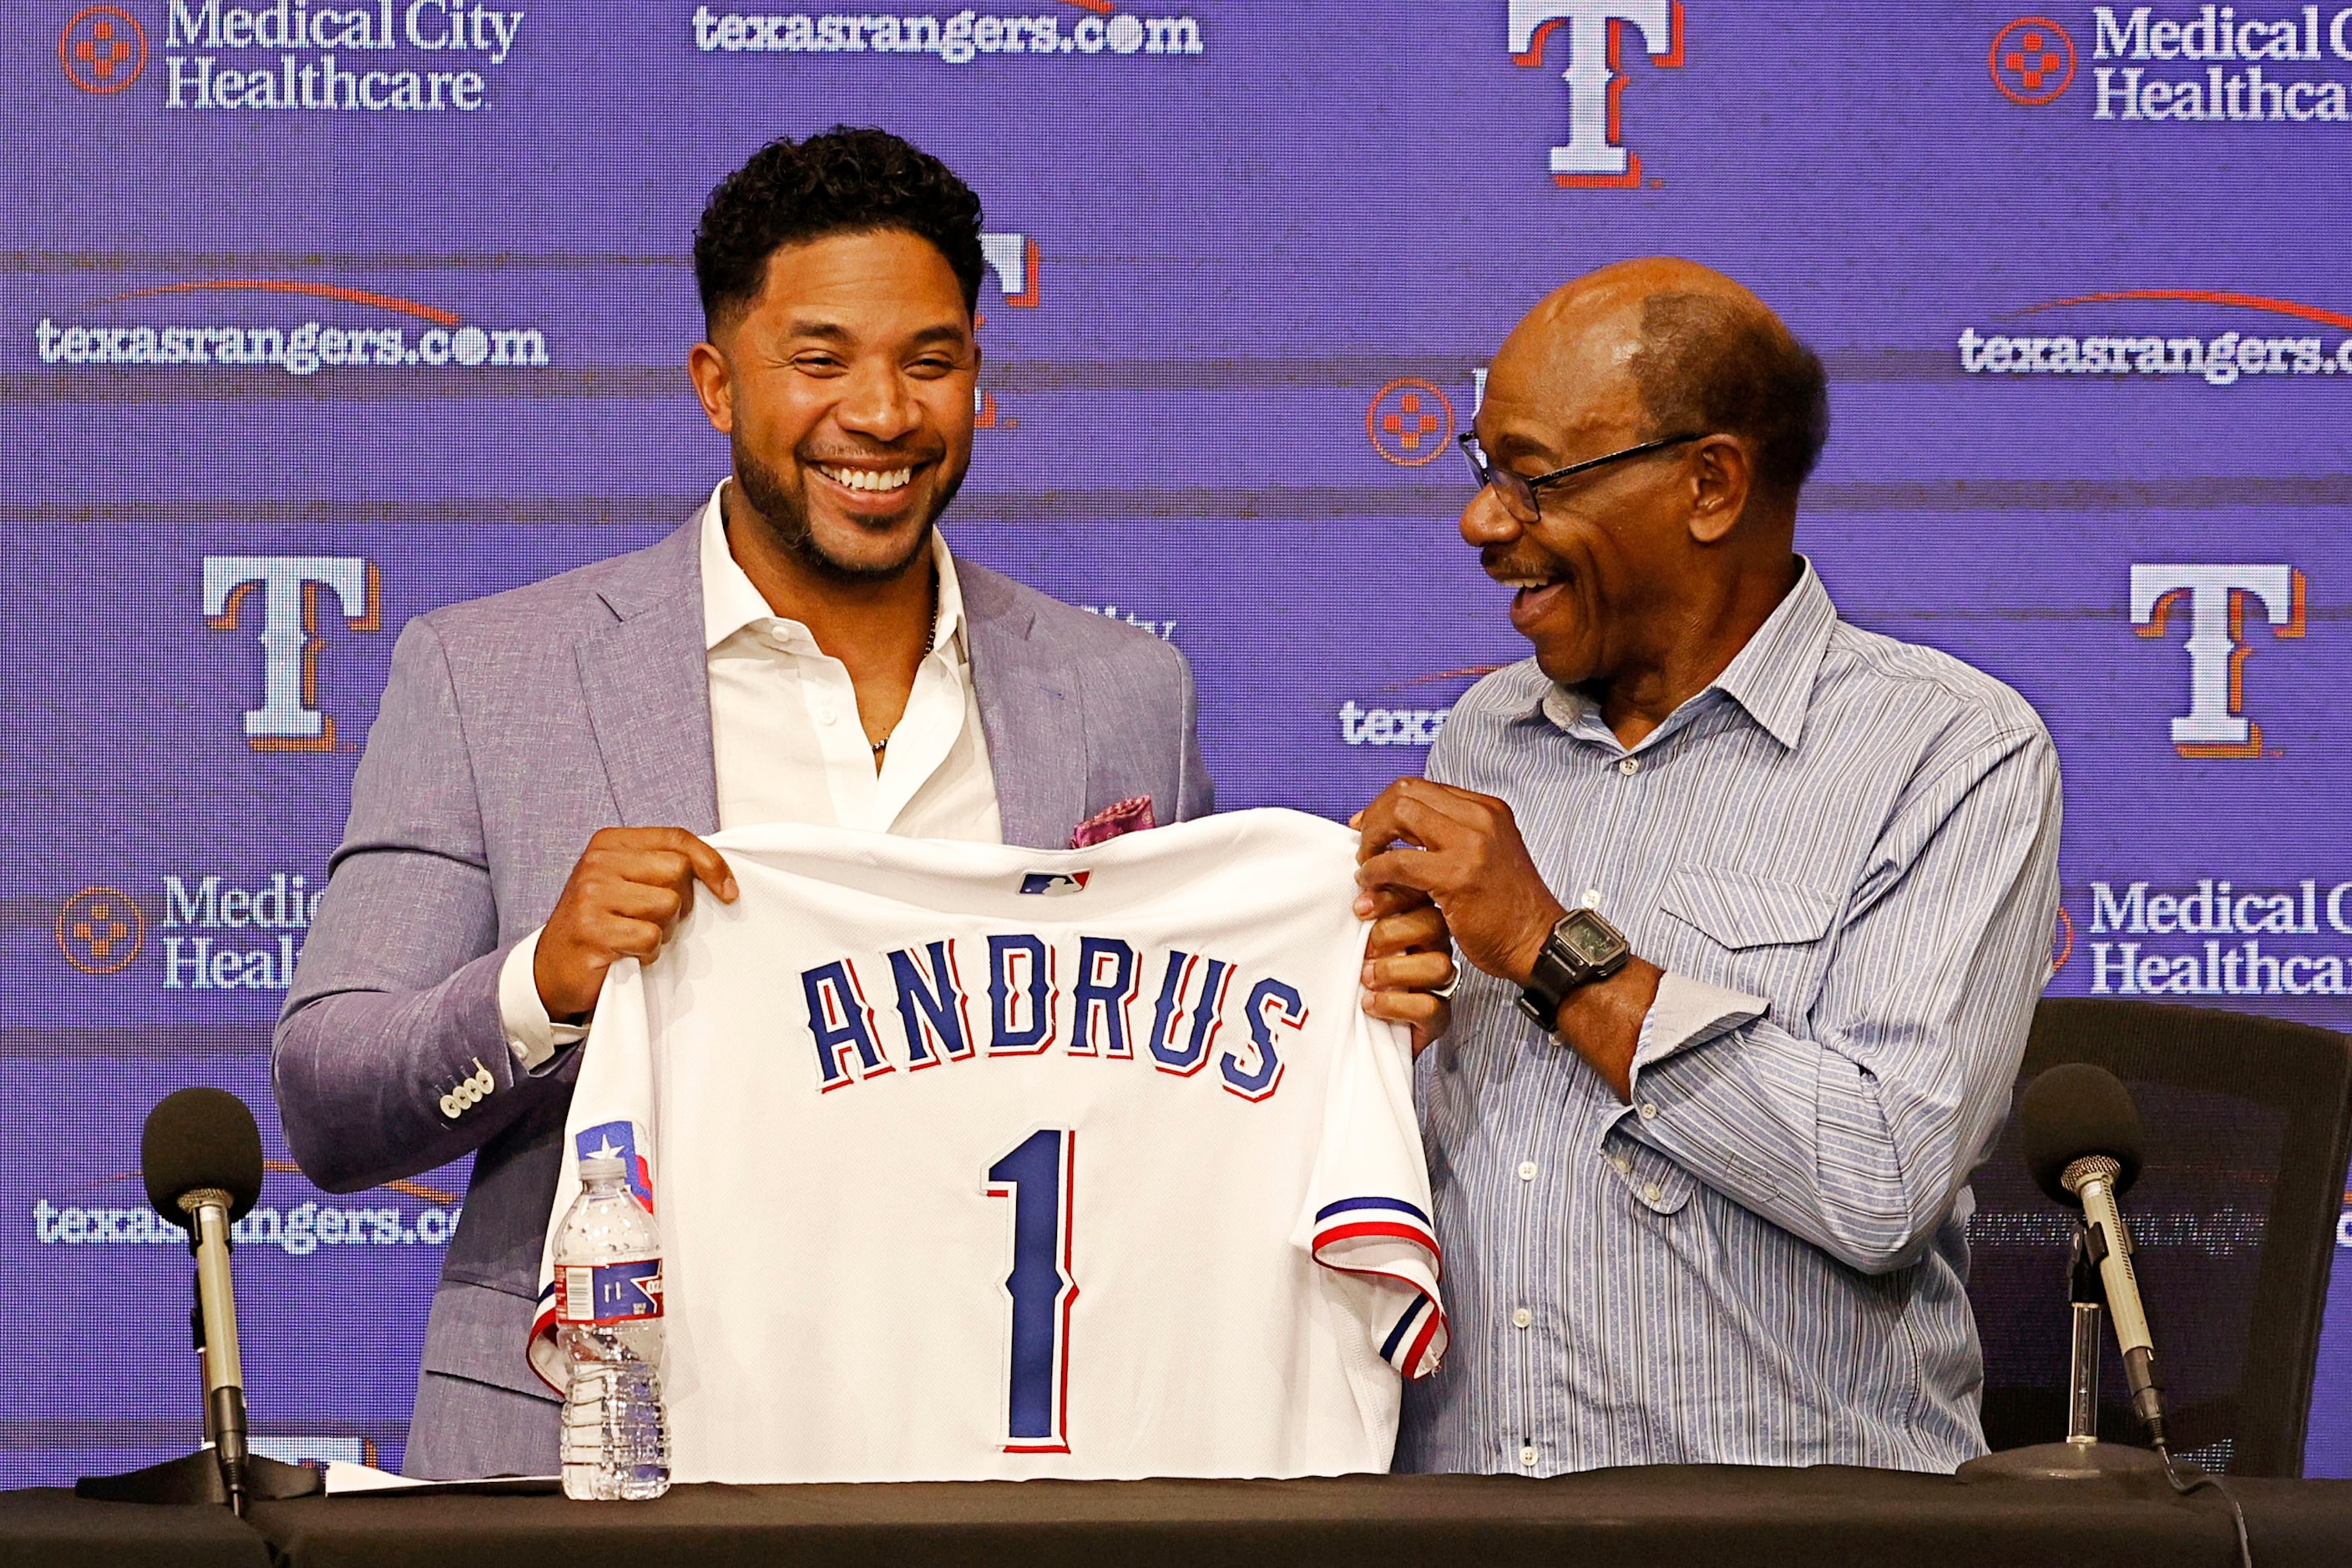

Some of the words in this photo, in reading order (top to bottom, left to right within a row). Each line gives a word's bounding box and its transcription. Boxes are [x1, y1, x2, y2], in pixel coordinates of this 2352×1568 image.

[165, 0, 395, 50] Medical
[405, 0, 524, 64] City
[692, 4, 1204, 63] texasrangers.com
[2092, 4, 2322, 61] Medical
[1508, 0, 1685, 188] T
[2092, 66, 2352, 121] Healthca
[35, 317, 549, 375] texasrangers.com
[203, 556, 381, 752] T
[2130, 563, 2306, 759] T
[2090, 878, 2319, 934] Medical
[162, 936, 302, 989] Heal
[797, 933, 1309, 1103] ANDRUS
[980, 1122, 1080, 1454] 1
